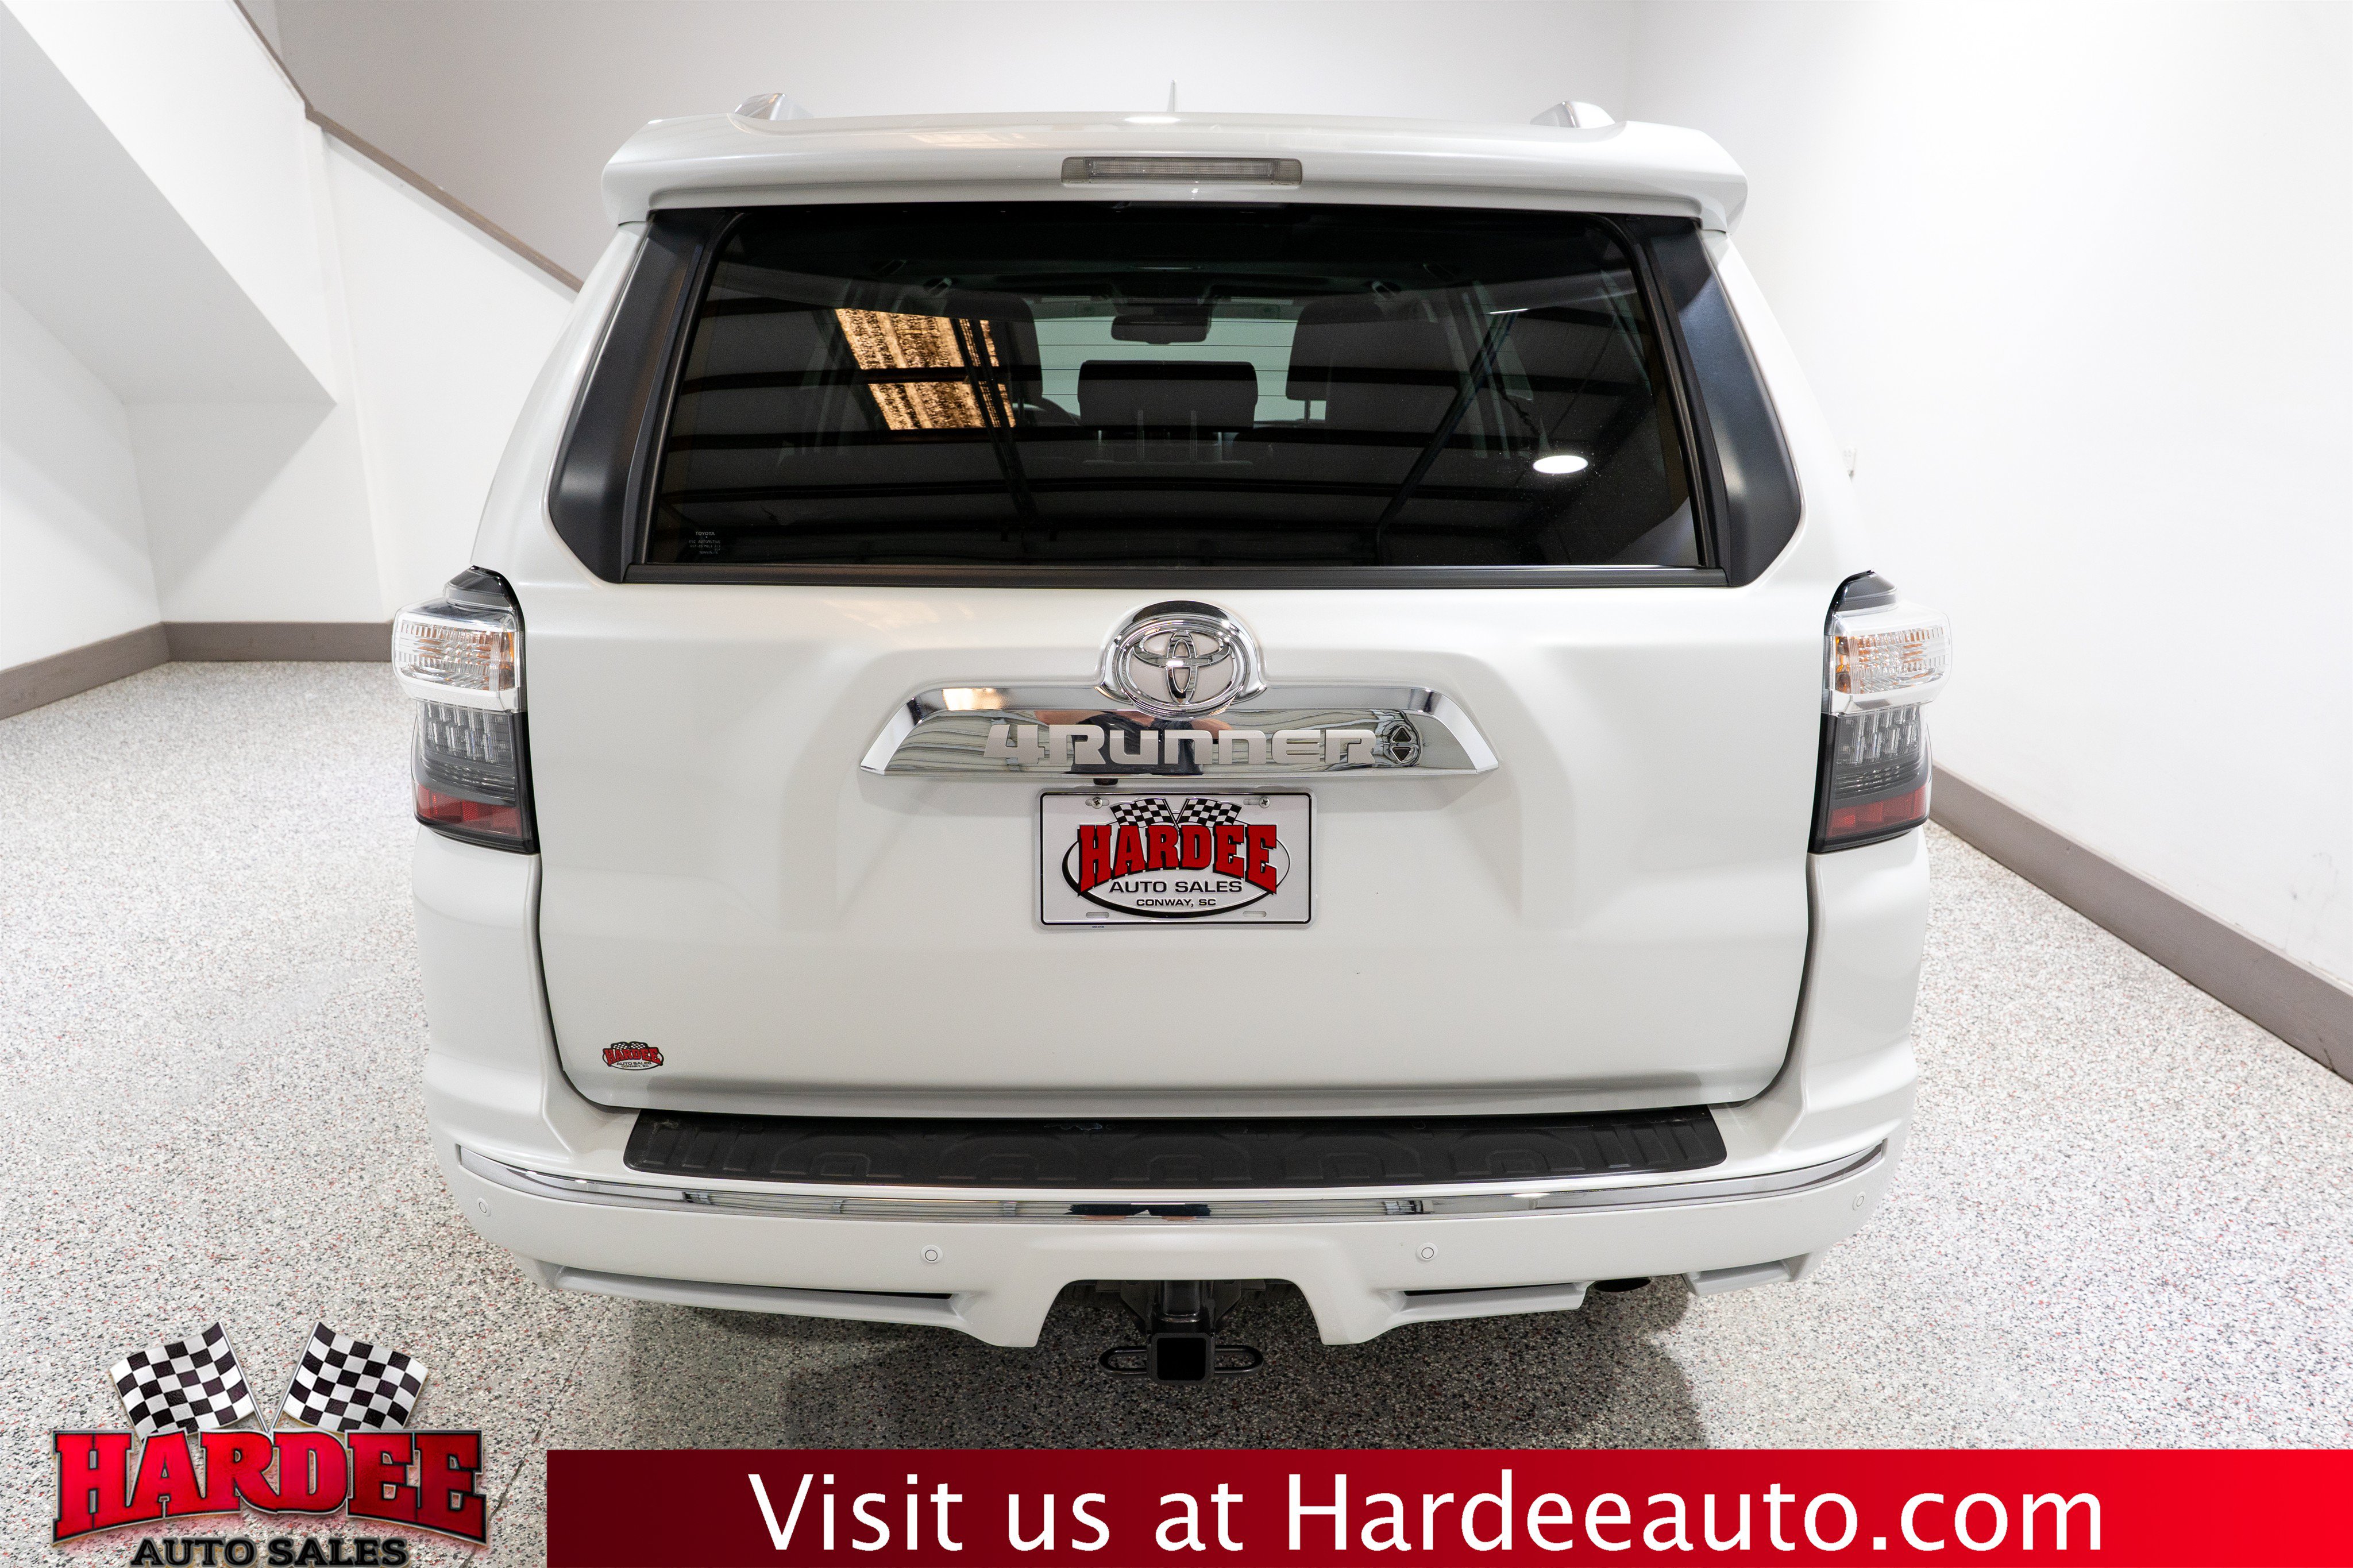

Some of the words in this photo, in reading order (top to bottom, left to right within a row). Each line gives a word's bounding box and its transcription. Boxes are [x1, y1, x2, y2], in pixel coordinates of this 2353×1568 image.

[1077, 823, 1278, 896] HARDEE
[1109, 881, 1168, 893] AUTO
[1175, 881, 1243, 893] SALES
[1136, 899, 1194, 907] CONWAY,
[1198, 899, 1217, 907] SC
[604, 1048, 662, 1065] HARDEE
